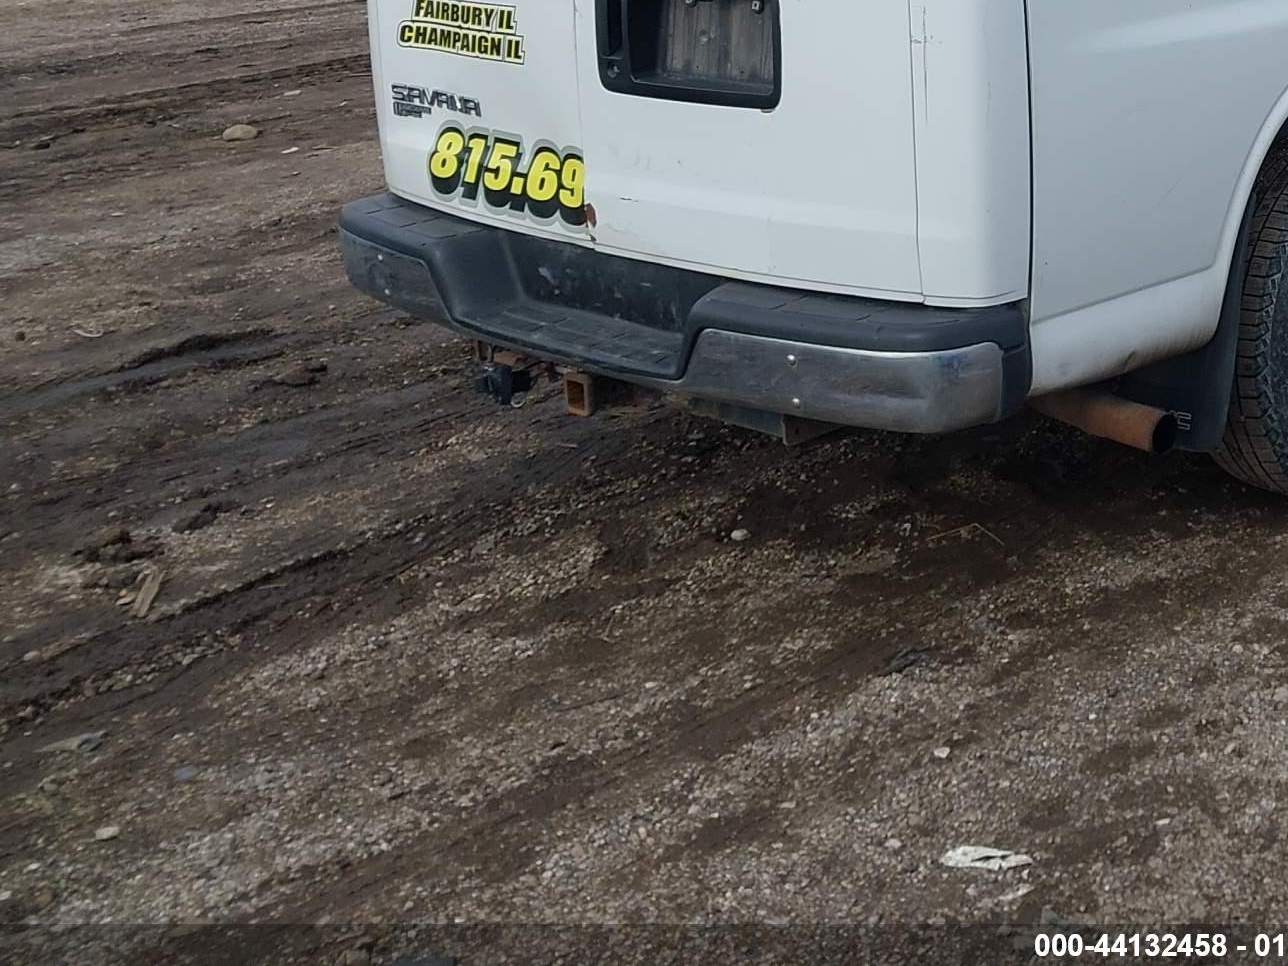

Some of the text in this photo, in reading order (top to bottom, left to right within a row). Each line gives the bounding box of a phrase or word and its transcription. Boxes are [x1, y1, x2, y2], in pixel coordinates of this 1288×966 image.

[498, 9, 516, 30] IL
[400, 25, 523, 60] CHAMPAIGN IL
[391, 84, 482, 117] SAVANA
[429, 130, 585, 210] 815.69
